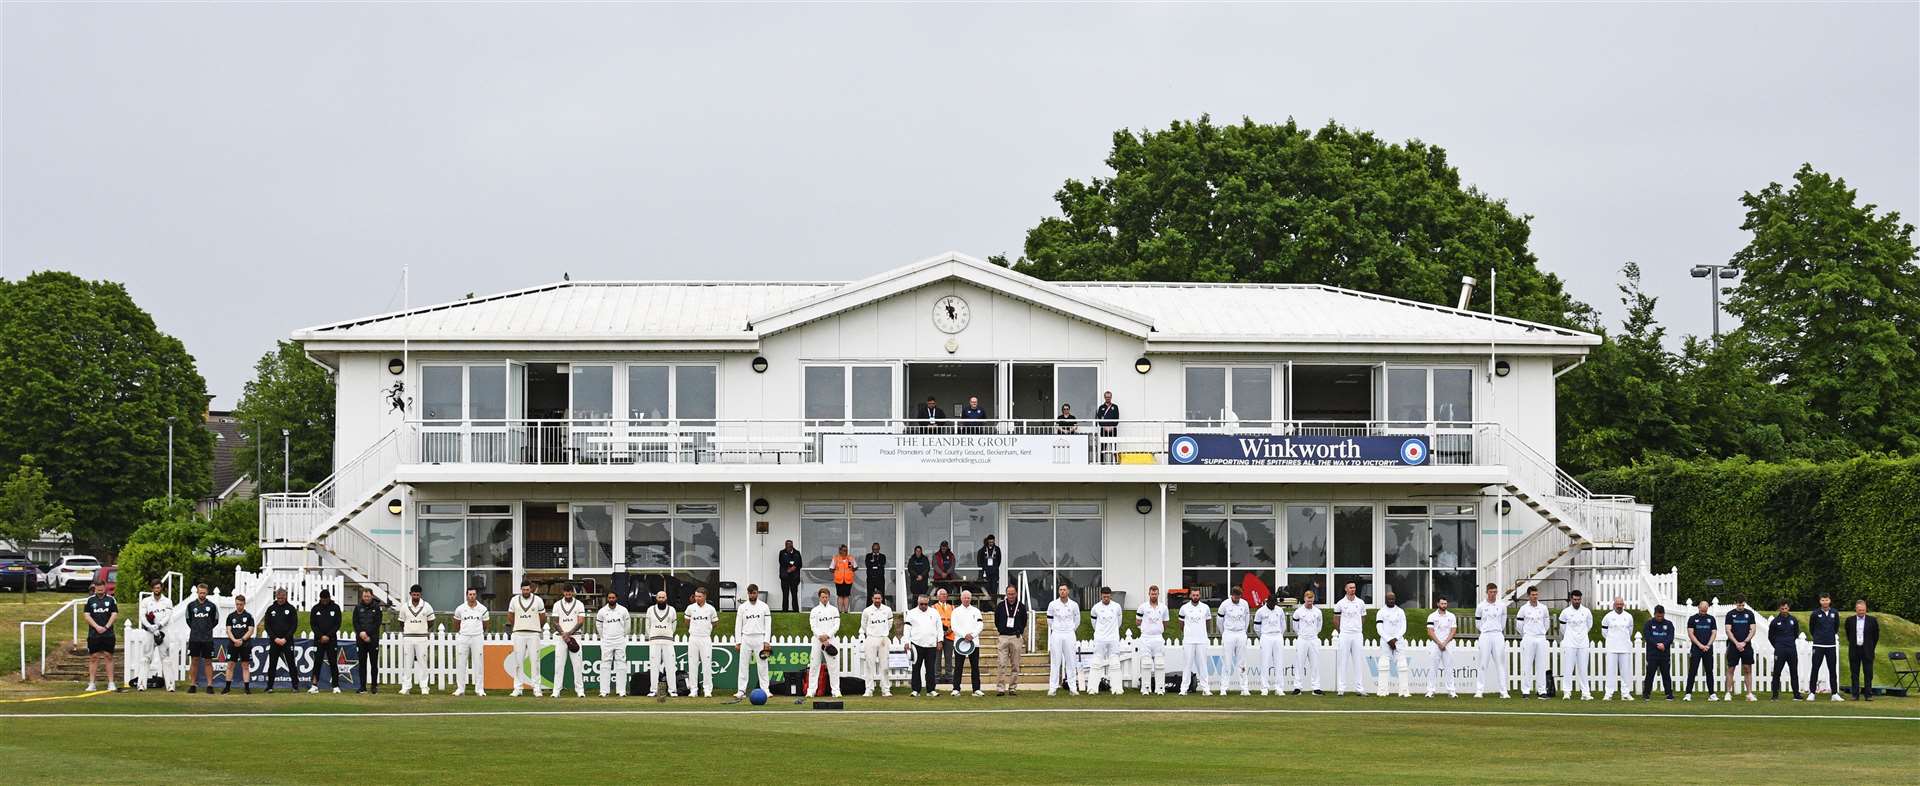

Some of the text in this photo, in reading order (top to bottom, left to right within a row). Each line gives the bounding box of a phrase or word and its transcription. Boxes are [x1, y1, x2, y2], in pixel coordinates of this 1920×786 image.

[895, 437, 1018, 447] THE LEANDER GROUP
[945, 449, 964, 457] County
[1239, 438, 1361, 459] Winkworth
